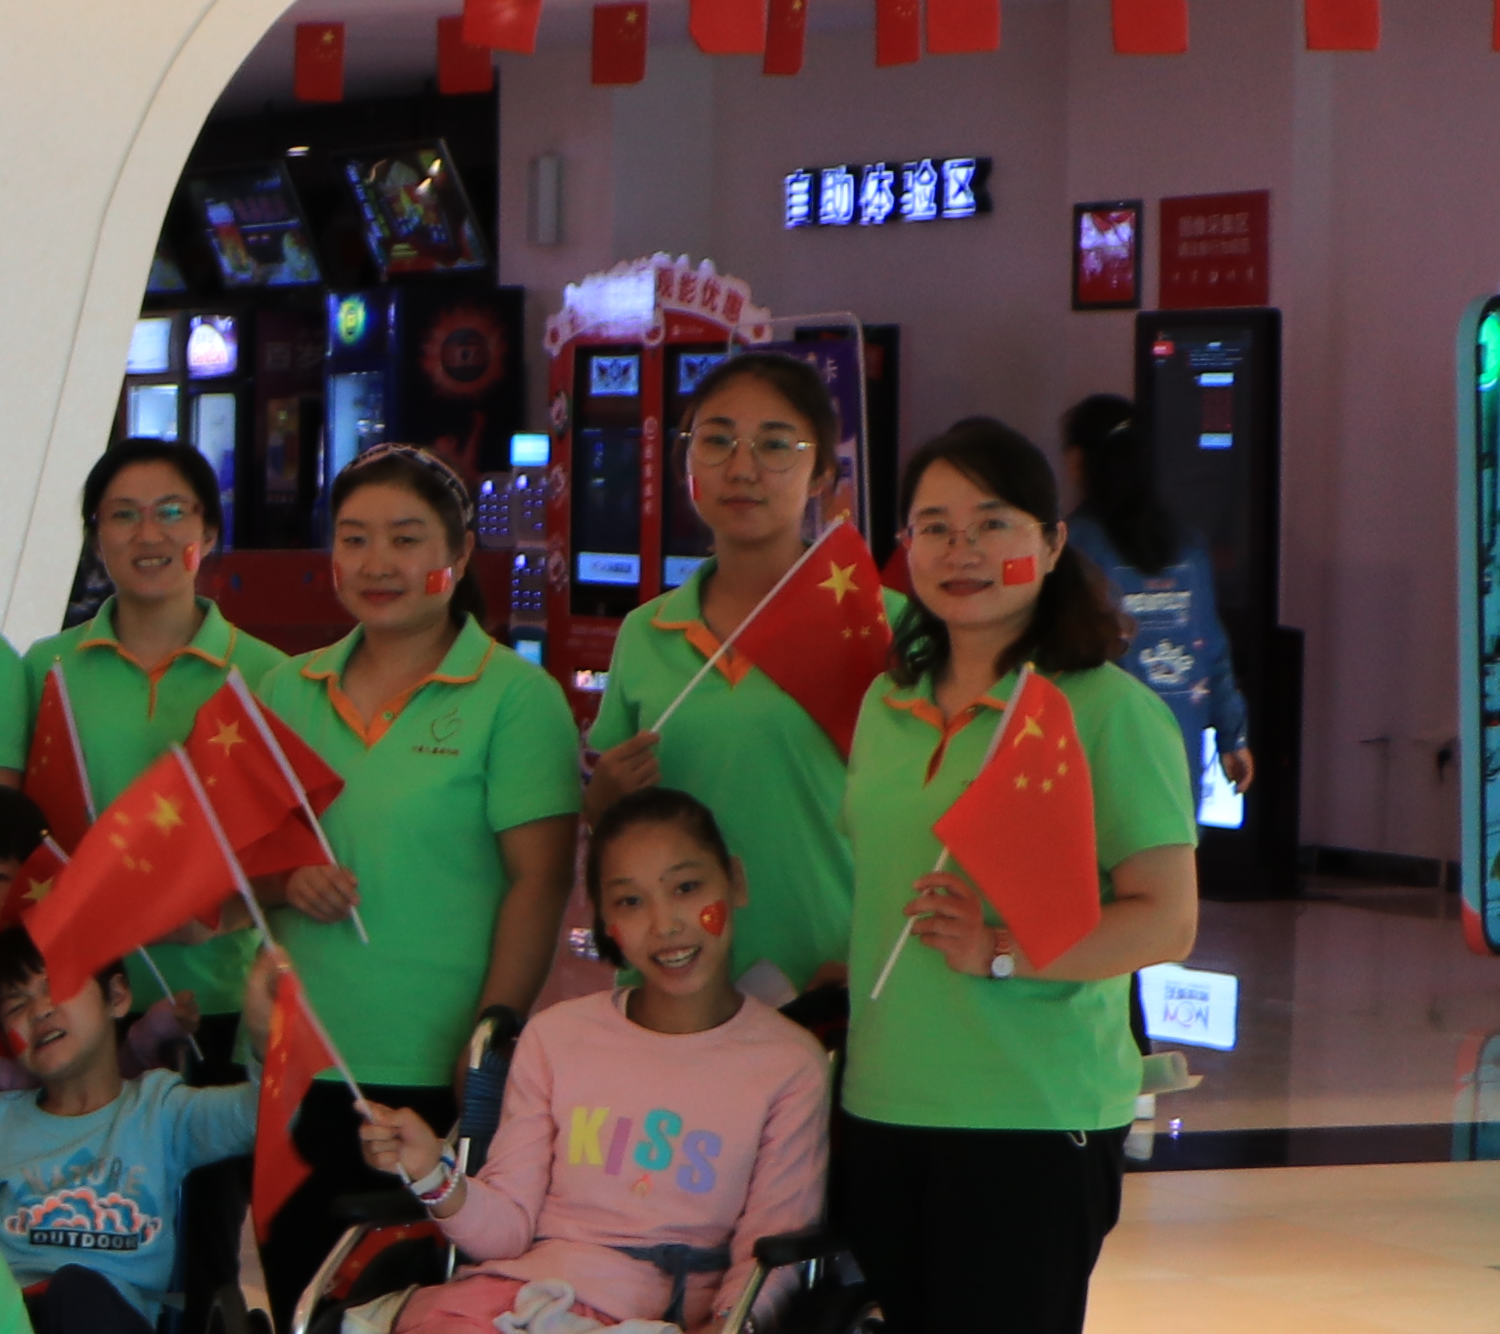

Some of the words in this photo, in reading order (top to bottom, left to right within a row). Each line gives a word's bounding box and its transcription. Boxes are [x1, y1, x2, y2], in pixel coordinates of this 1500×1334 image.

[784, 158, 977, 228] 自助体验区
[567, 1105, 724, 1195] KISS
